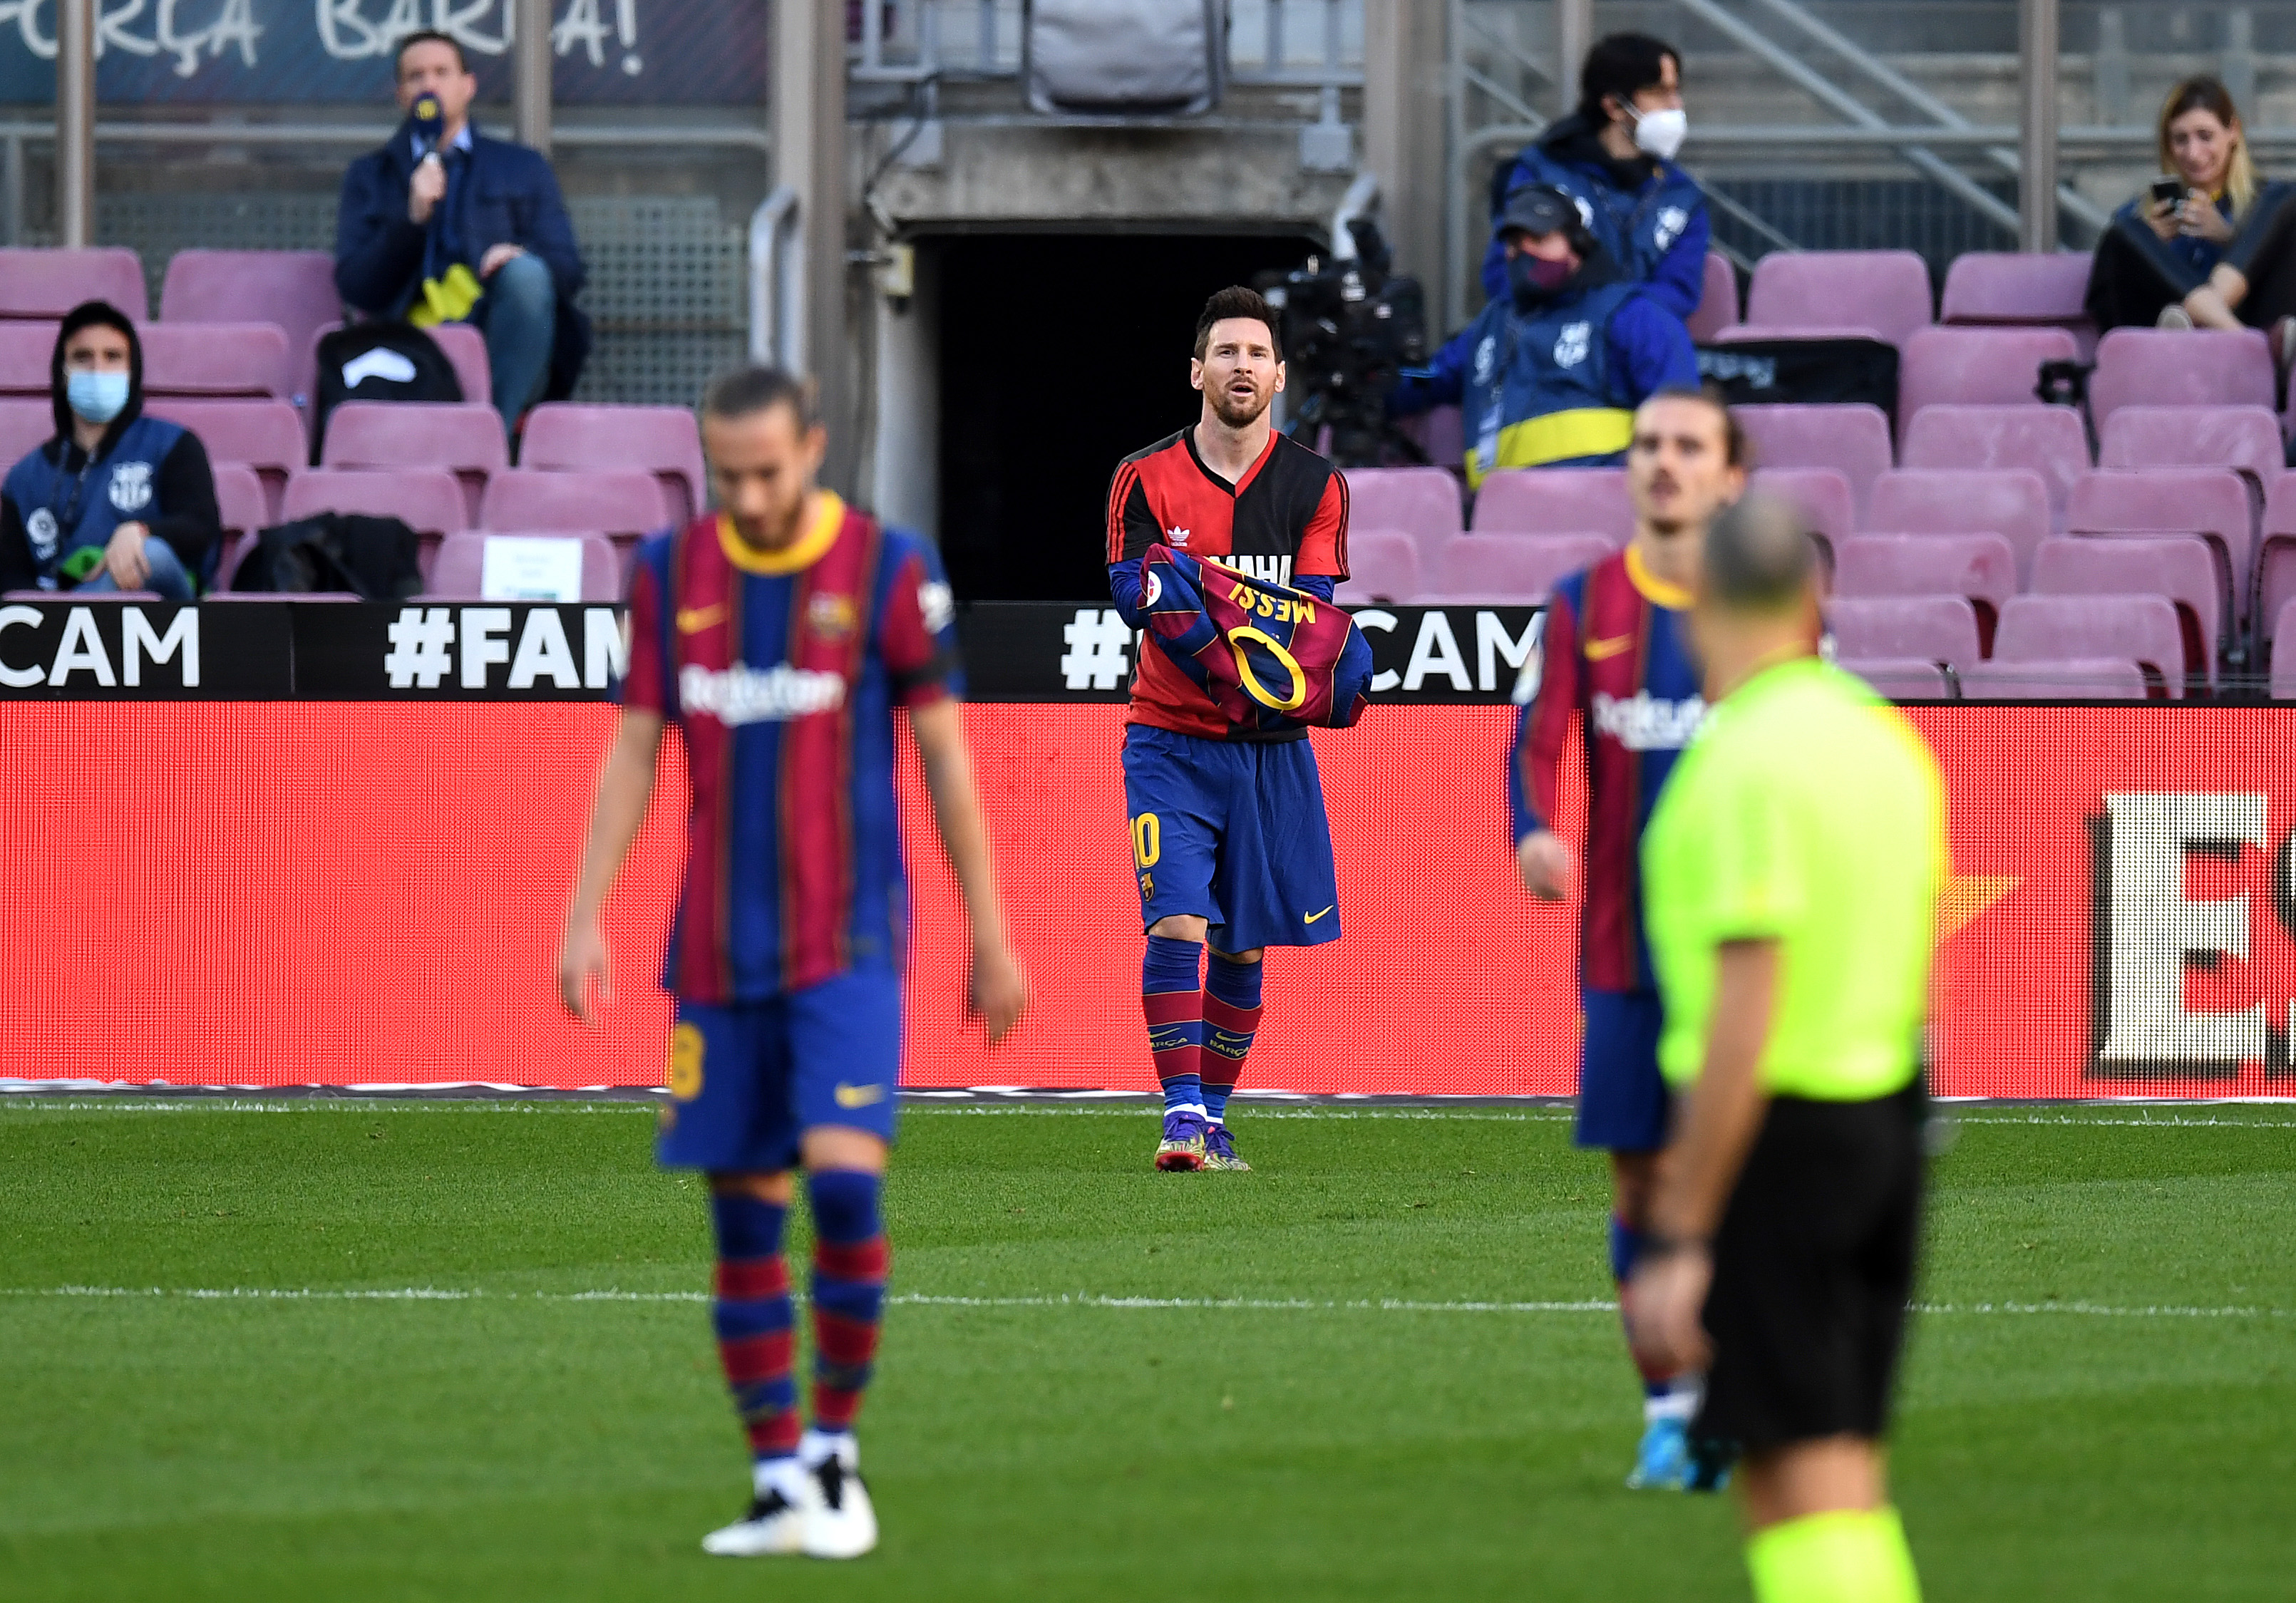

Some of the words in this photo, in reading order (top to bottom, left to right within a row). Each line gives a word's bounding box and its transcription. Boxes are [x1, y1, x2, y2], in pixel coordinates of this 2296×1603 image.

[316, 0, 643, 76] BARA!
[1228, 582, 1316, 624] MESSI
[0, 605, 200, 688] CAM
[1129, 812, 1160, 872] 10
[2085, 791, 2296, 1078] E
